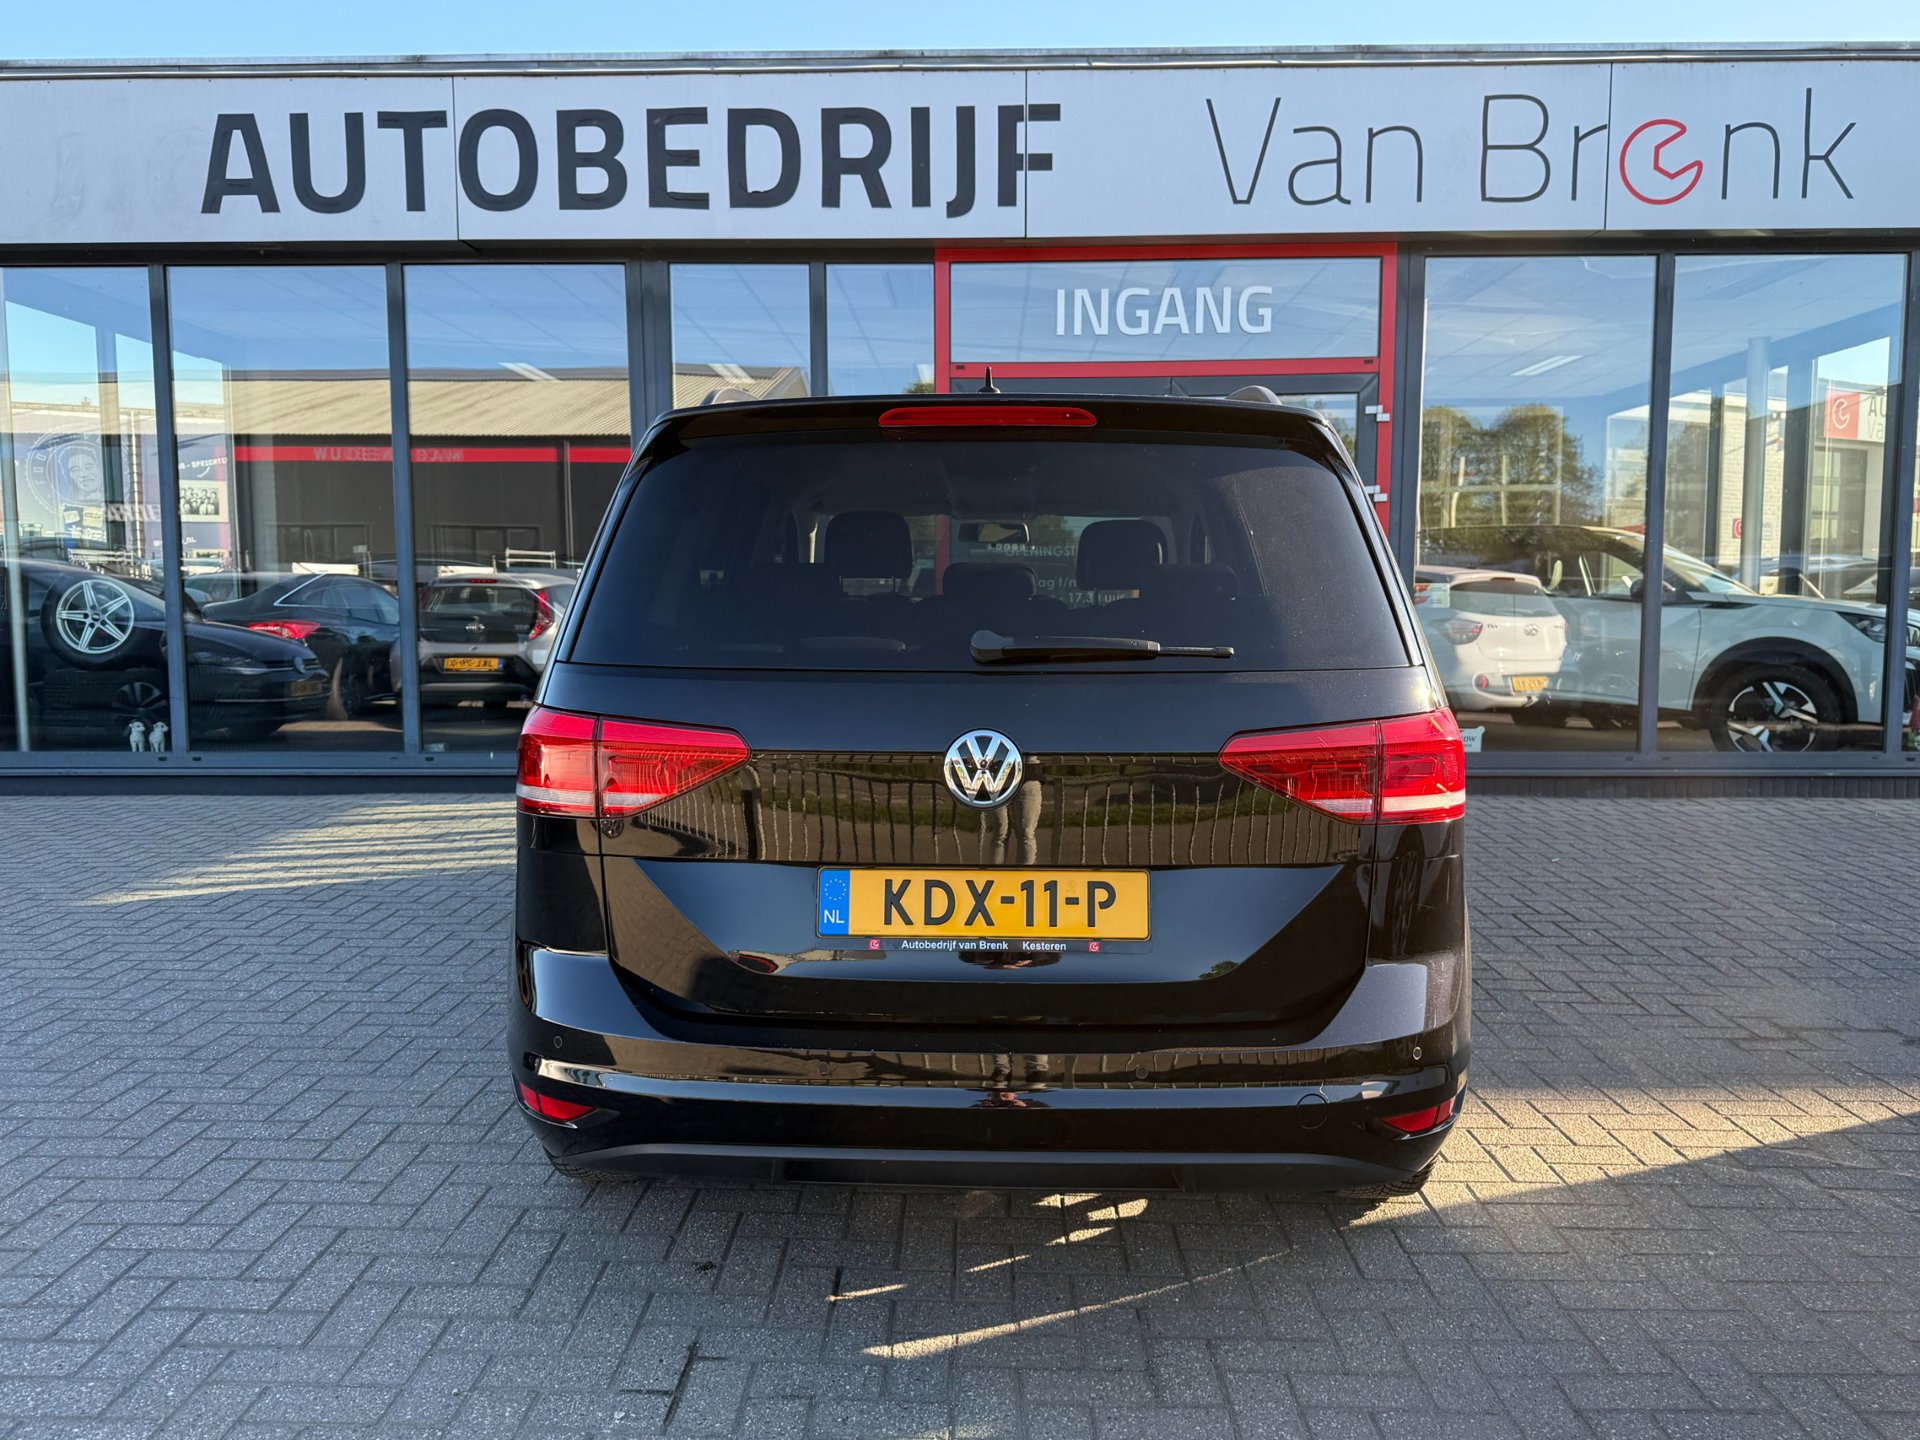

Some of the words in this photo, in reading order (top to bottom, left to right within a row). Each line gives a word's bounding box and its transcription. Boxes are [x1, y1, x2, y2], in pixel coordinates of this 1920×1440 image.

[200, 103, 1062, 218] AUTOBEDRIJF
[1205, 96, 1423, 206] Van
[1055, 285, 1273, 336] INGANG
[823, 909, 846, 924] NL
[883, 878, 1117, 927] KDX-11-P
[901, 939, 956, 951] Autobedrijf
[958, 941, 977, 950] van
[979, 941, 1009, 950] Brenk
[1022, 941, 1067, 951] Kesteren
